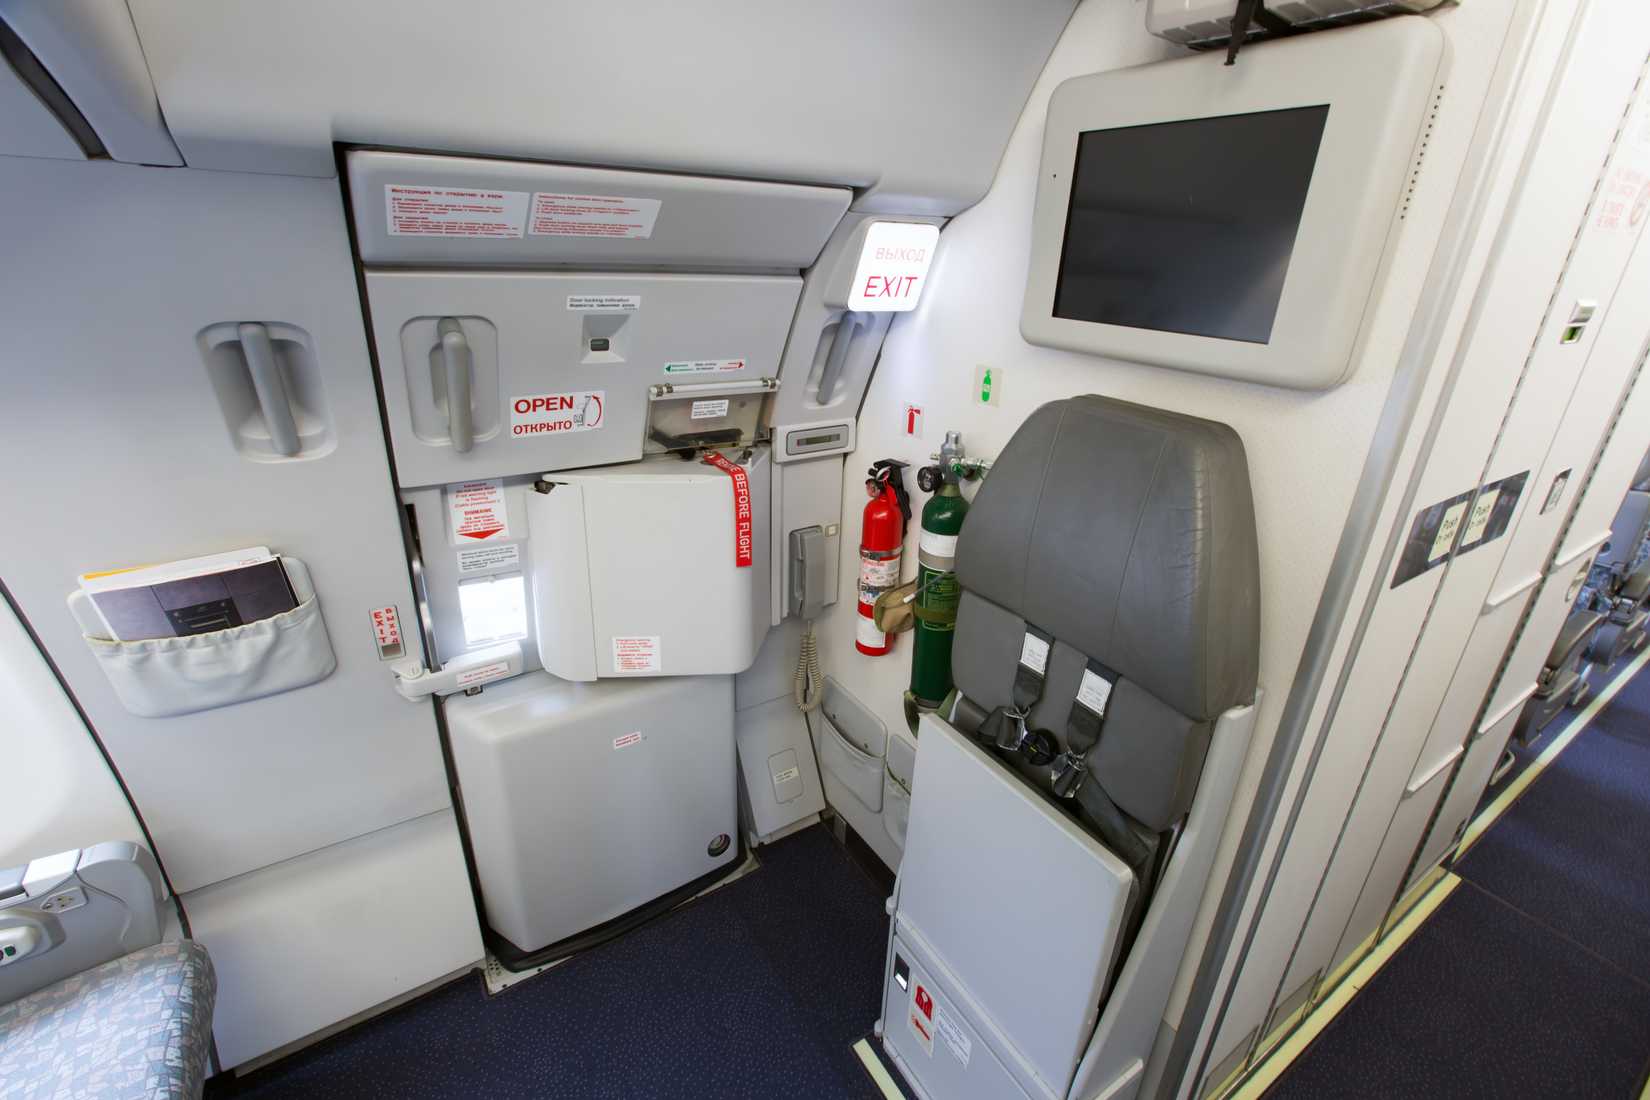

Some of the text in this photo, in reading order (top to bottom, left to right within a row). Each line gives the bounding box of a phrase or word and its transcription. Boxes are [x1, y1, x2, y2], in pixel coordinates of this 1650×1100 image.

[875, 247, 926, 264] ВЫХОД
[863, 276, 918, 297] EXIT
[514, 395, 574, 414] OPEN
[513, 420, 573, 435] ОТКРЫТО
[734, 473, 751, 559] BEFORE FLIGHT
[373, 611, 387, 643] EXIT
